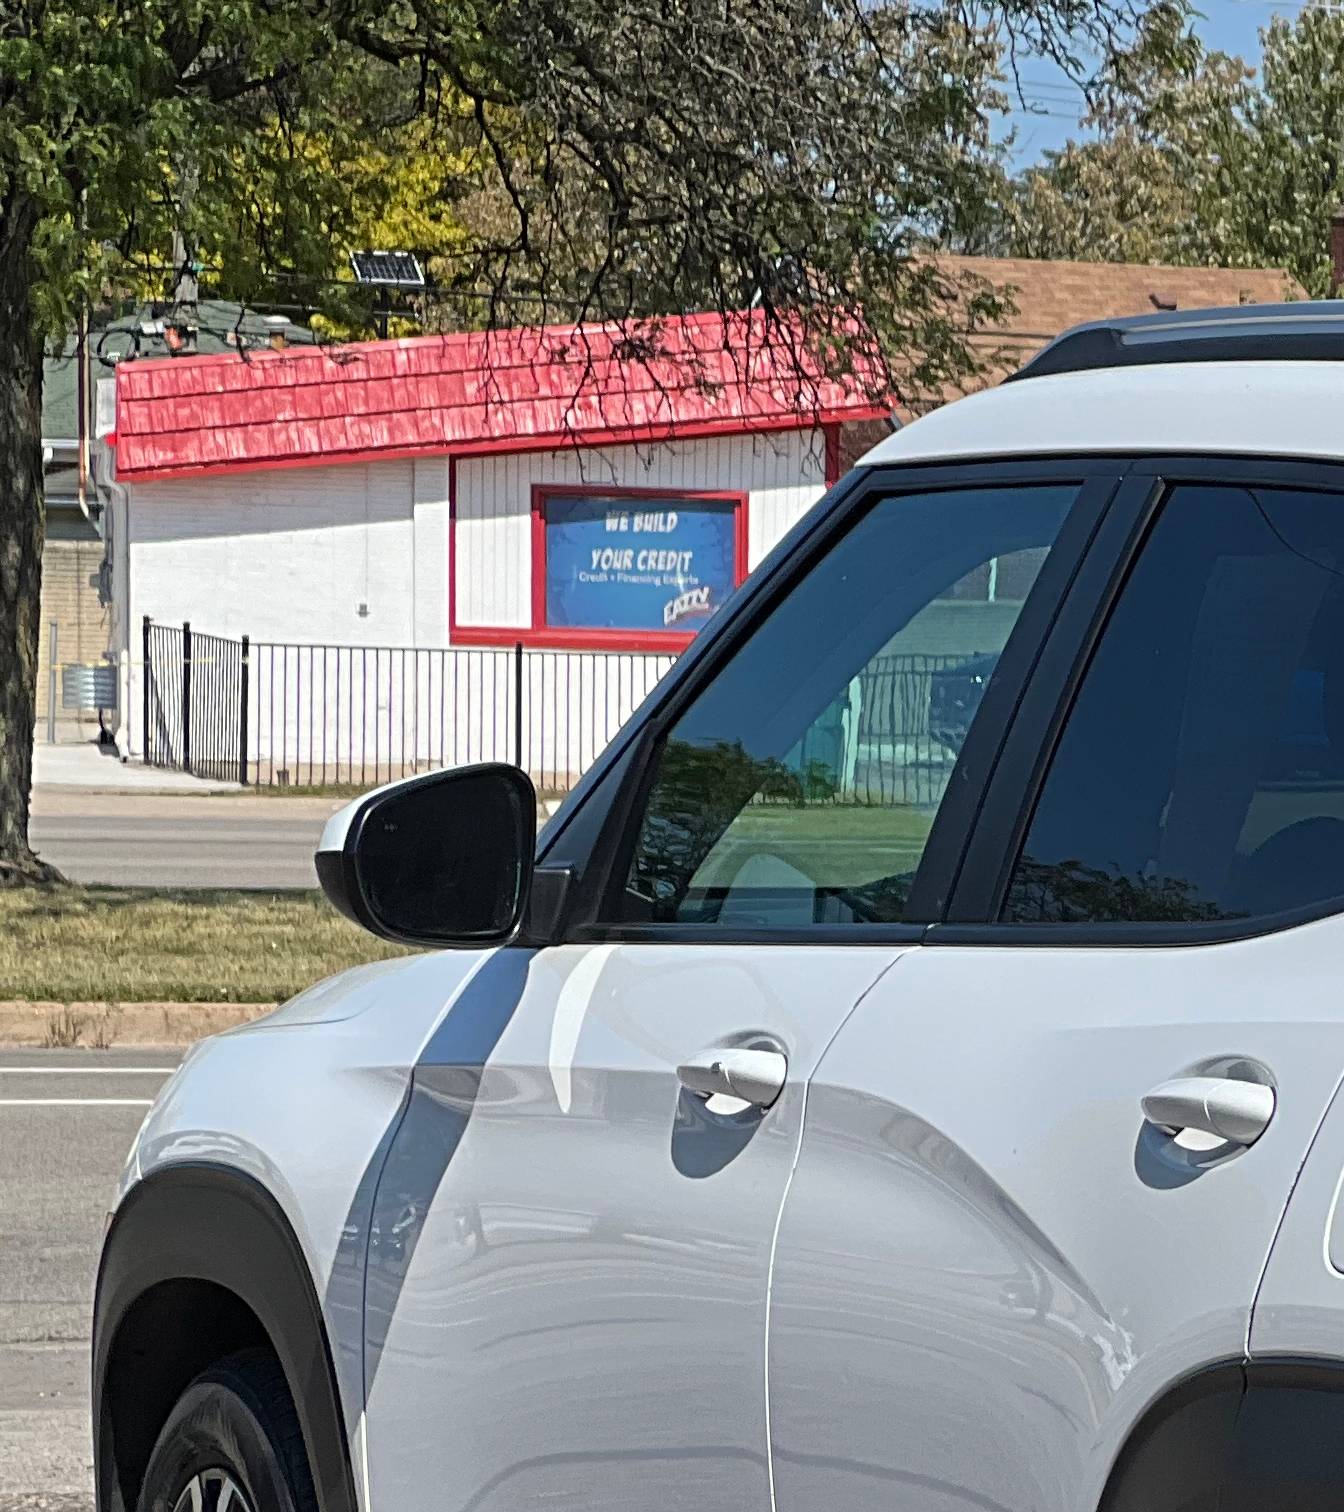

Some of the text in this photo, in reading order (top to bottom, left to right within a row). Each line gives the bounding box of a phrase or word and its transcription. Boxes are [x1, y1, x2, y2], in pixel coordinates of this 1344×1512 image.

[606, 511, 679, 533] WE BUILD
[591, 547, 694, 573] YOUR CREDIT
[578, 571, 609, 583] Credit
[617, 572, 662, 588] Financing
